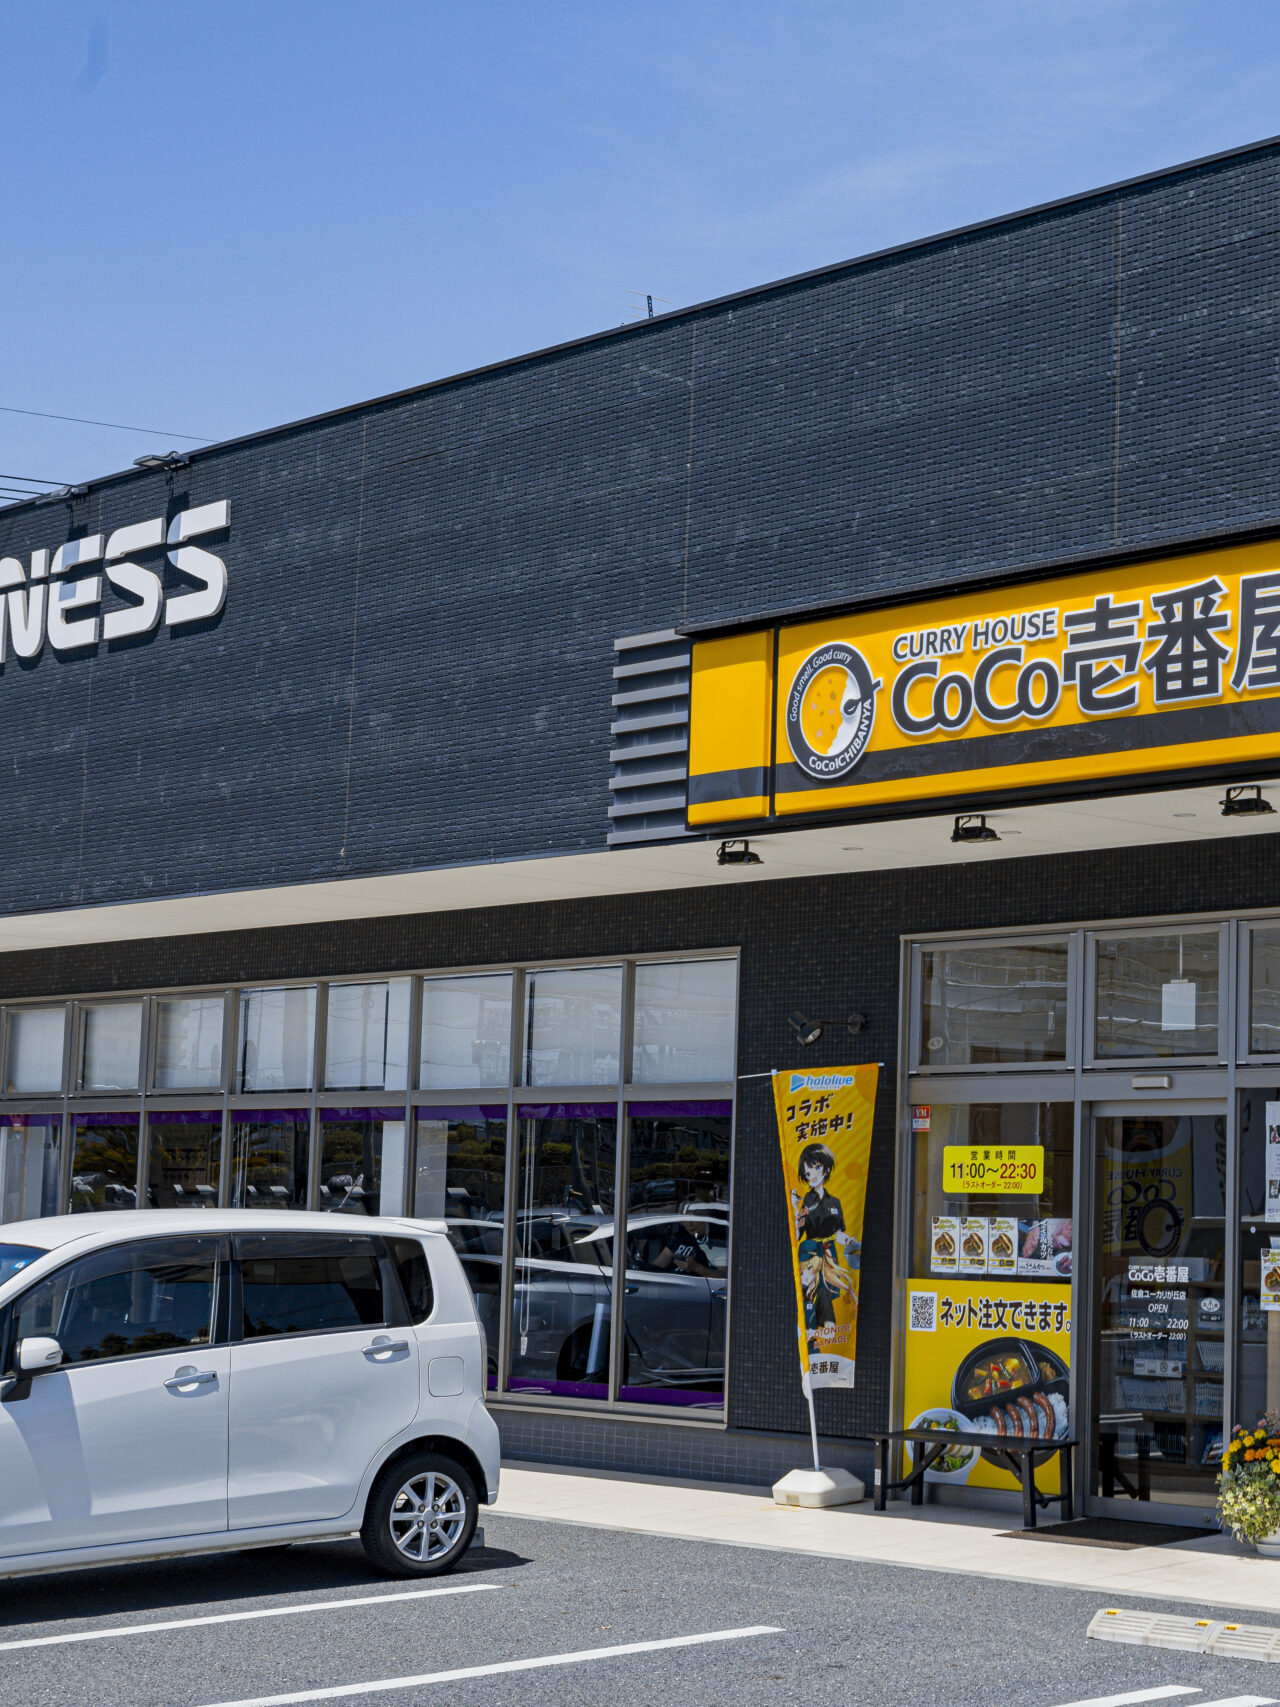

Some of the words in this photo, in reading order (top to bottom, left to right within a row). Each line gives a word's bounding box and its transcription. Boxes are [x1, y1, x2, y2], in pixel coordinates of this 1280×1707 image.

[892, 624, 969, 661] CURRY
[971, 608, 1058, 651] HOUSE
[790, 691, 800, 721] Good
[796, 665, 813, 692] smell.
[812, 649, 833, 668] Good
[833, 651, 852, 664] curry
[809, 699, 872, 771] CoCoICHIBANYA
[806, 1075, 853, 1086] hololive
[787, 1093, 834, 1122] コラボ
[971, 1150, 1016, 1160] 営業時間
[1129, 1265, 1188, 1282] CoCo壱番屋
[940, 1297, 1071, 1333] ネット注文できます。
[1148, 1304, 1168, 1313] OPEN
[1129, 1318, 1149, 1328] 11:00
[1167, 1319, 1188, 1330] 22:00
